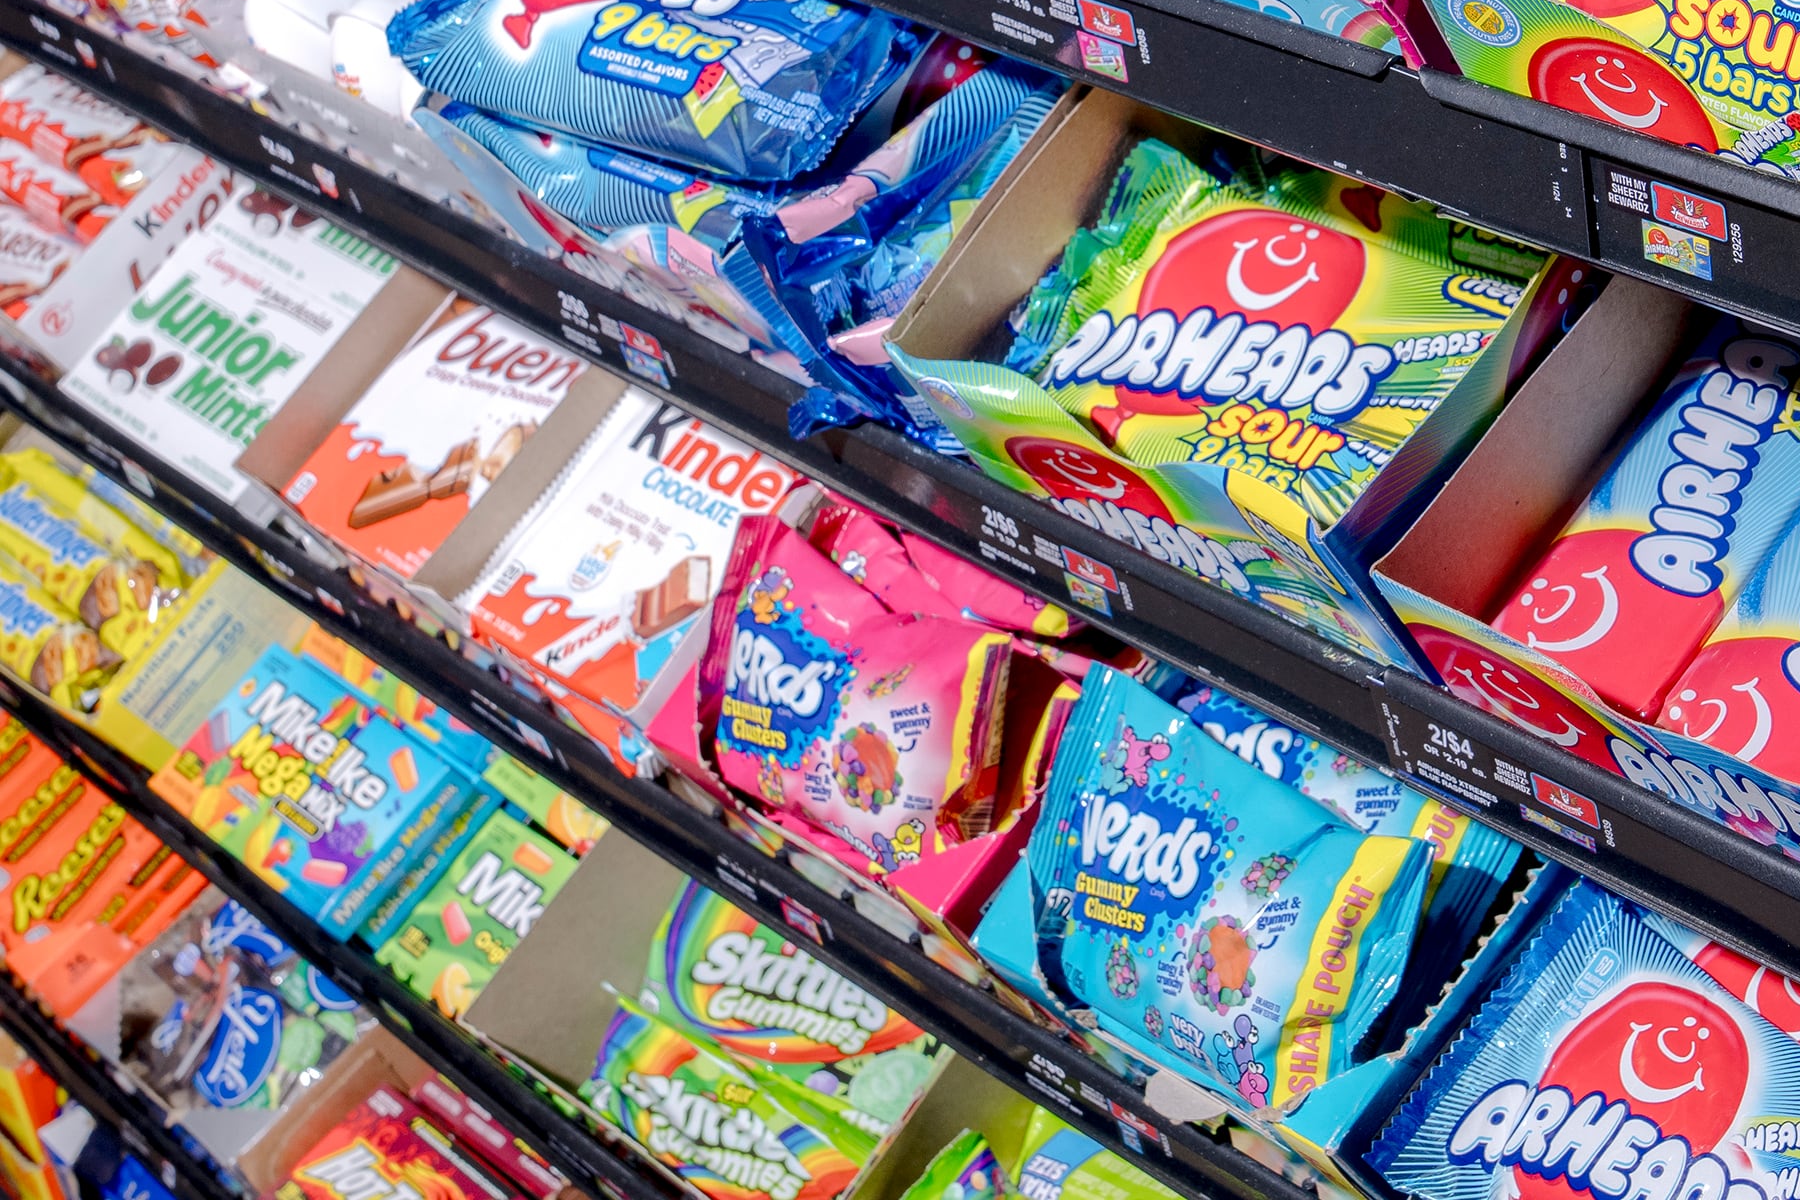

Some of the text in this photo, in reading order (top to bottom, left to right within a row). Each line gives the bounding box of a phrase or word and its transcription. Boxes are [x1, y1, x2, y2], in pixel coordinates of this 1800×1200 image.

[597, 4, 740, 61] 9 bars
[588, 45, 690, 82] ASSORTED FLAVORS
[1730, 222, 1745, 264] 129256
[130, 273, 304, 386] Junior
[436, 308, 585, 395] buen
[1047, 312, 1393, 416] AIRHEADS
[1207, 405, 1345, 468] sour
[642, 467, 740, 529] CHOCOLATE
[720, 694, 773, 728] Gummy
[731, 719, 788, 752] Clusters
[229, 726, 313, 799] Mega
[246, 681, 388, 811] Mike Ike
[1427, 722, 1475, 761] 2/$4
[1354, 796, 1401, 816] gummy
[1355, 785, 1388, 799] sweet
[1416, 759, 1499, 804] AIRHEADS XTREMES
[1418, 767, 1492, 808] BLUE RASPBERRY
[1080, 794, 1213, 898] Nerds
[1074, 872, 1140, 908] Gummy
[1083, 902, 1147, 935] Clusters
[1312, 882, 1375, 998] POUCH
[692, 930, 890, 1031] Skittles
[203, 995, 279, 1104] York
[708, 985, 871, 1056] Gummies
